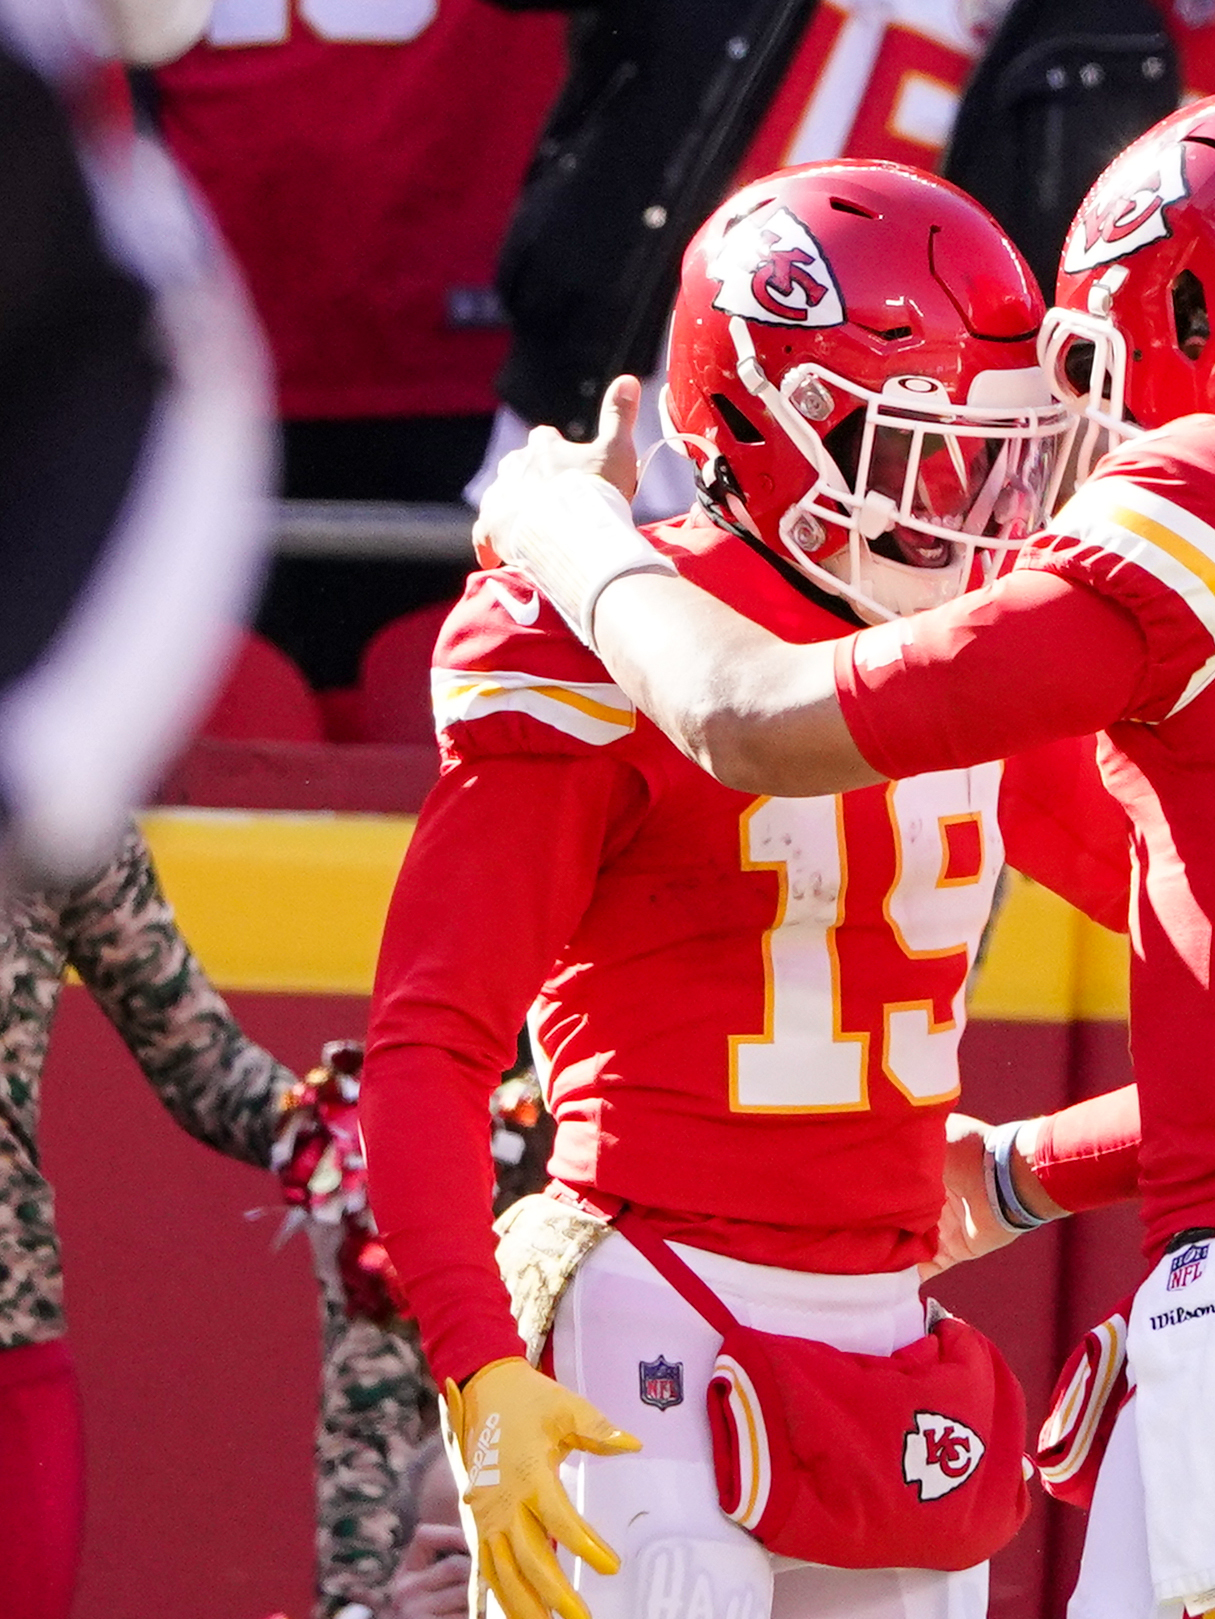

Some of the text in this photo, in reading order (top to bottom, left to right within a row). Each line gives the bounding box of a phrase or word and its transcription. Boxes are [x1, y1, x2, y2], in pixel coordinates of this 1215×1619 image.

[728, 758, 1006, 1114] 19
[1171, 1261, 1203, 1289] NFL
[1150, 1303, 1215, 1331] Wilson
[647, 1378, 679, 1400] NFL
[923, 1425, 971, 1478] KC
